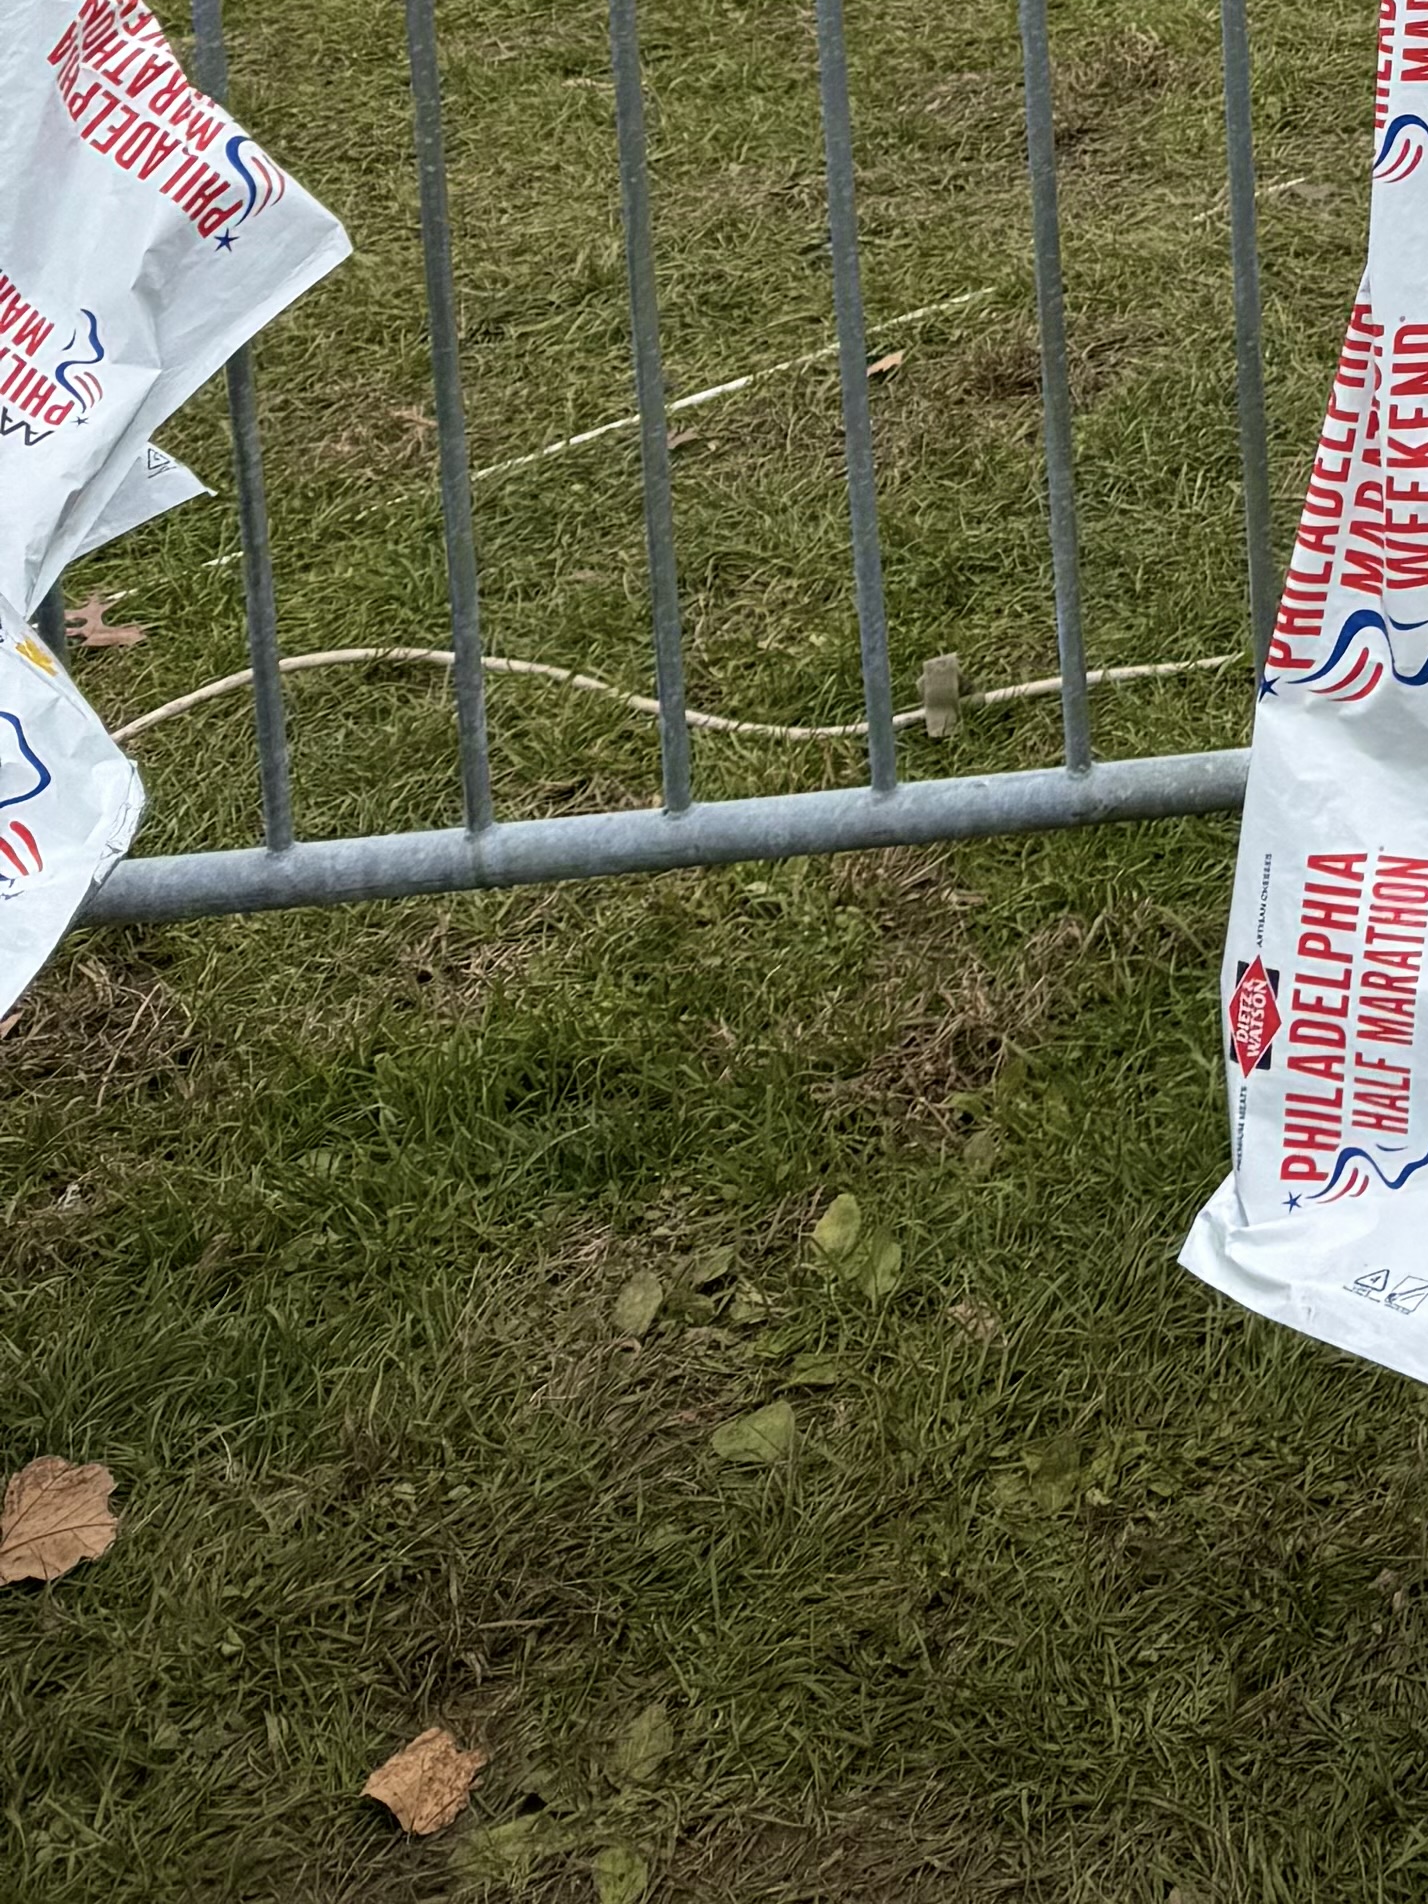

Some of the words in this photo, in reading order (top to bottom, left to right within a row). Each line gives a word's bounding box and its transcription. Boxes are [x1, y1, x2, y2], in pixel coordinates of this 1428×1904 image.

[1235, 992, 1254, 1044] DIETZ
[1246, 977, 1269, 1057] WATSON
[1279, 852, 1369, 1182] PHILADELPHIA
[1351, 1052, 1412, 1135] HALF
